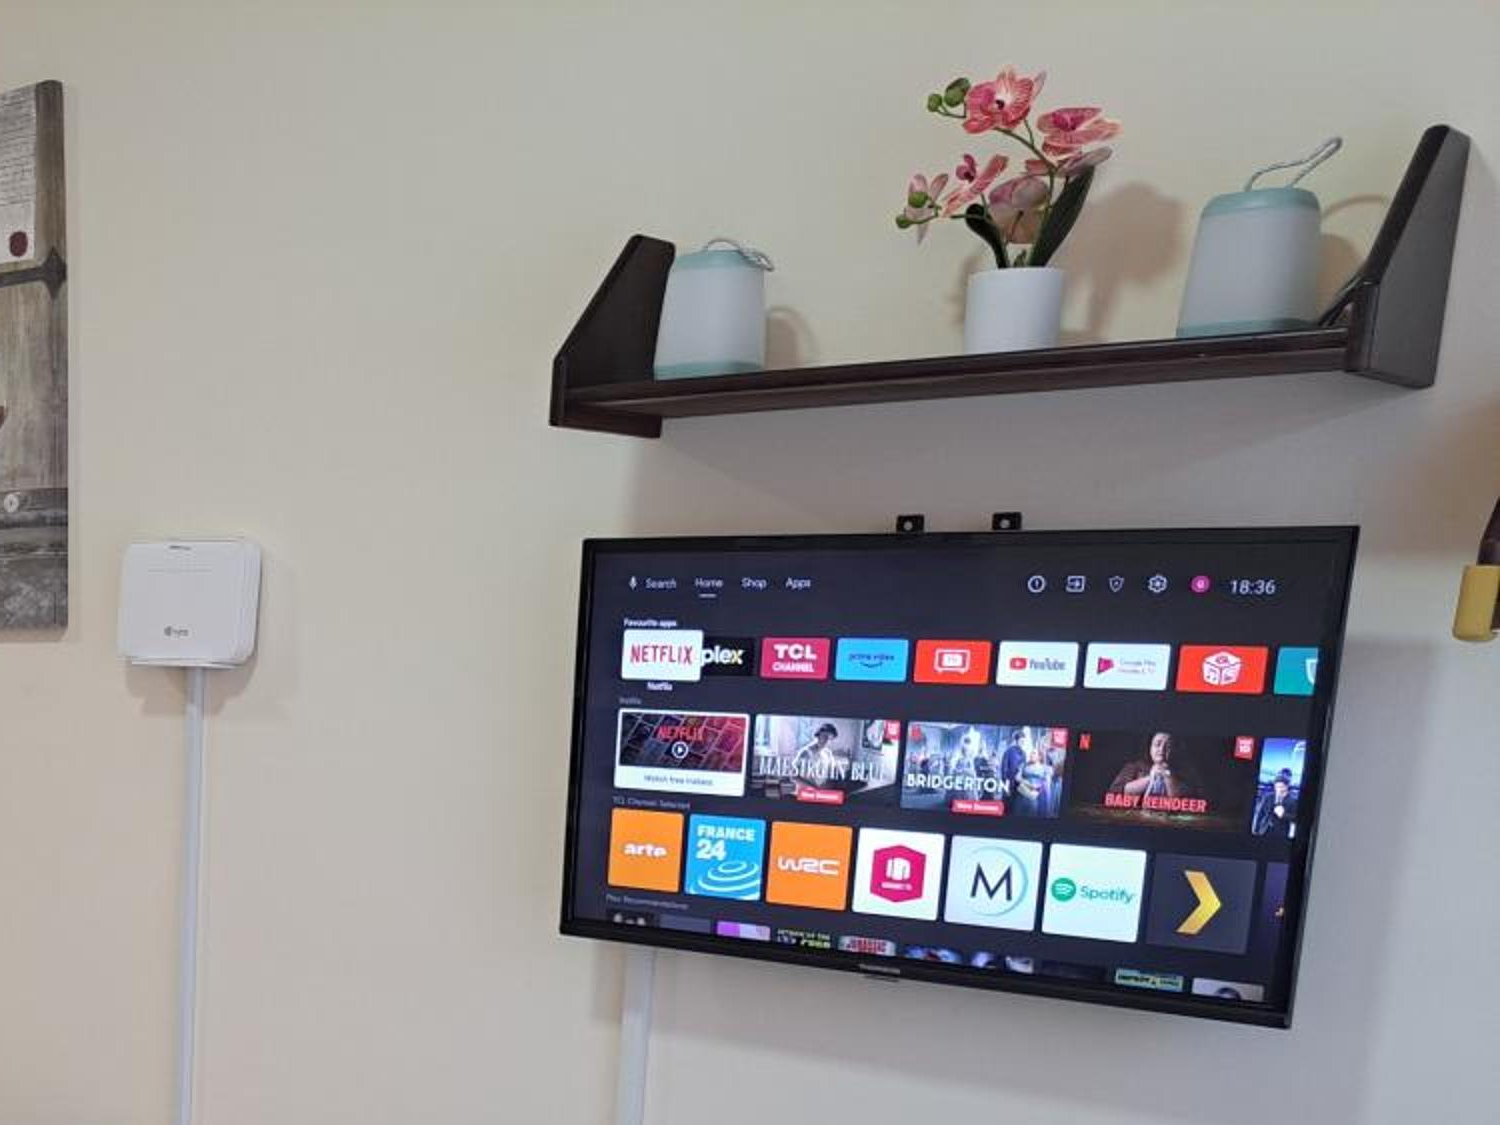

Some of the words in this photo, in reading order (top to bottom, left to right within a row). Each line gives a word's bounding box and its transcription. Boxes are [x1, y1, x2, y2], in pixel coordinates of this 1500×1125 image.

[646, 577, 676, 589] Search
[695, 577, 724, 588] Home
[741, 577, 767, 591] Shop
[785, 577, 812, 591] Apps
[1230, 578, 1276, 595] 18:36
[630, 644, 693, 665] NETFLIX
[701, 645, 744, 667] plex
[773, 643, 817, 660] TCL
[772, 661, 815, 674] CHANNEL
[1029, 658, 1066, 672] YouTube
[656, 725, 703, 741] NETFLIX
[829, 760, 849, 780] IN
[906, 773, 1010, 794] BRIDGERTON
[1104, 792, 1139, 808] BABY
[1143, 794, 1207, 813] REINDEER
[696, 824, 756, 842] FRANCE
[624, 842, 668, 858] arte
[696, 839, 726, 861] 24
[778, 855, 840, 876] WRC
[969, 862, 1013, 901] M
[1080, 884, 1134, 904] Spotify
